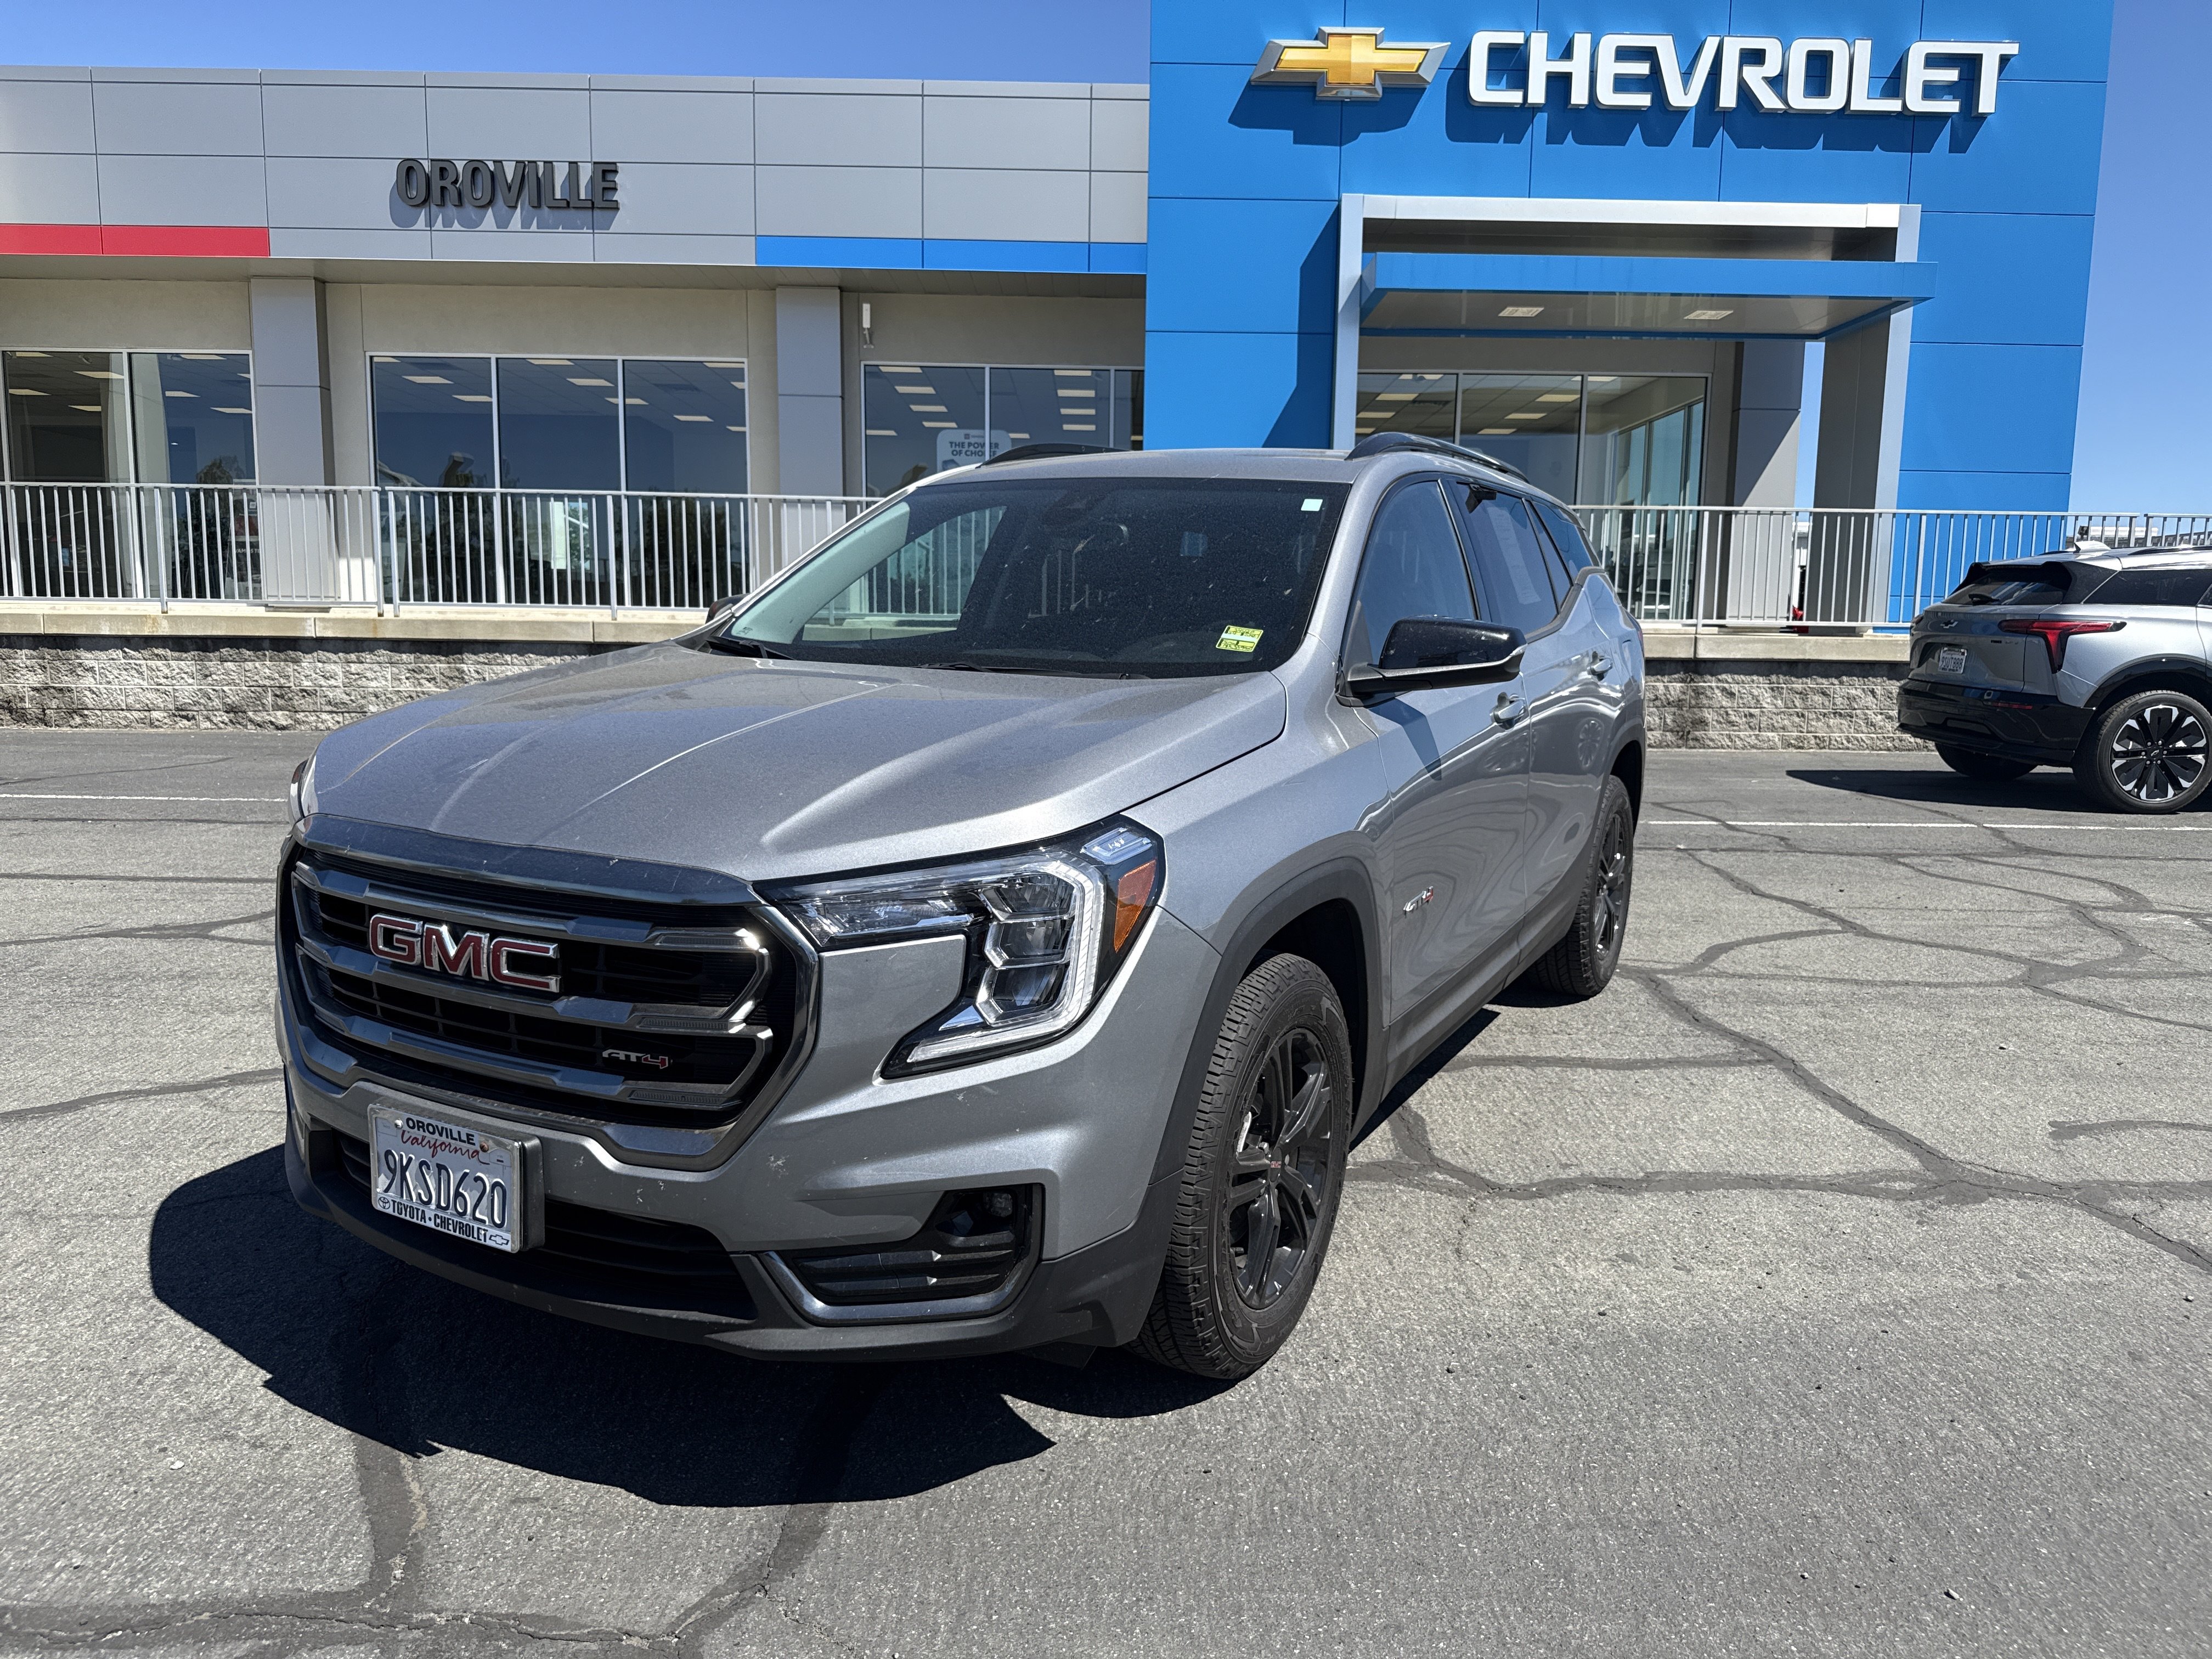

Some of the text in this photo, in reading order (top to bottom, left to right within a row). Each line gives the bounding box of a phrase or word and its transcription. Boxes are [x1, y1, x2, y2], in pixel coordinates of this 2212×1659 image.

[1468, 30, 2021, 116] CHEVROLET
[396, 159, 619, 210] OROVILLE
[1940, 656, 1963, 669] 9SUT888
[369, 913, 561, 993] GMC
[602, 1049, 669, 1069] AT4
[401, 1129, 490, 1165] California
[405, 1117, 476, 1146] OROVILLE
[384, 1149, 507, 1229] 9KSD620
[391, 1199, 489, 1243] TOYOTA CHEVROLET
